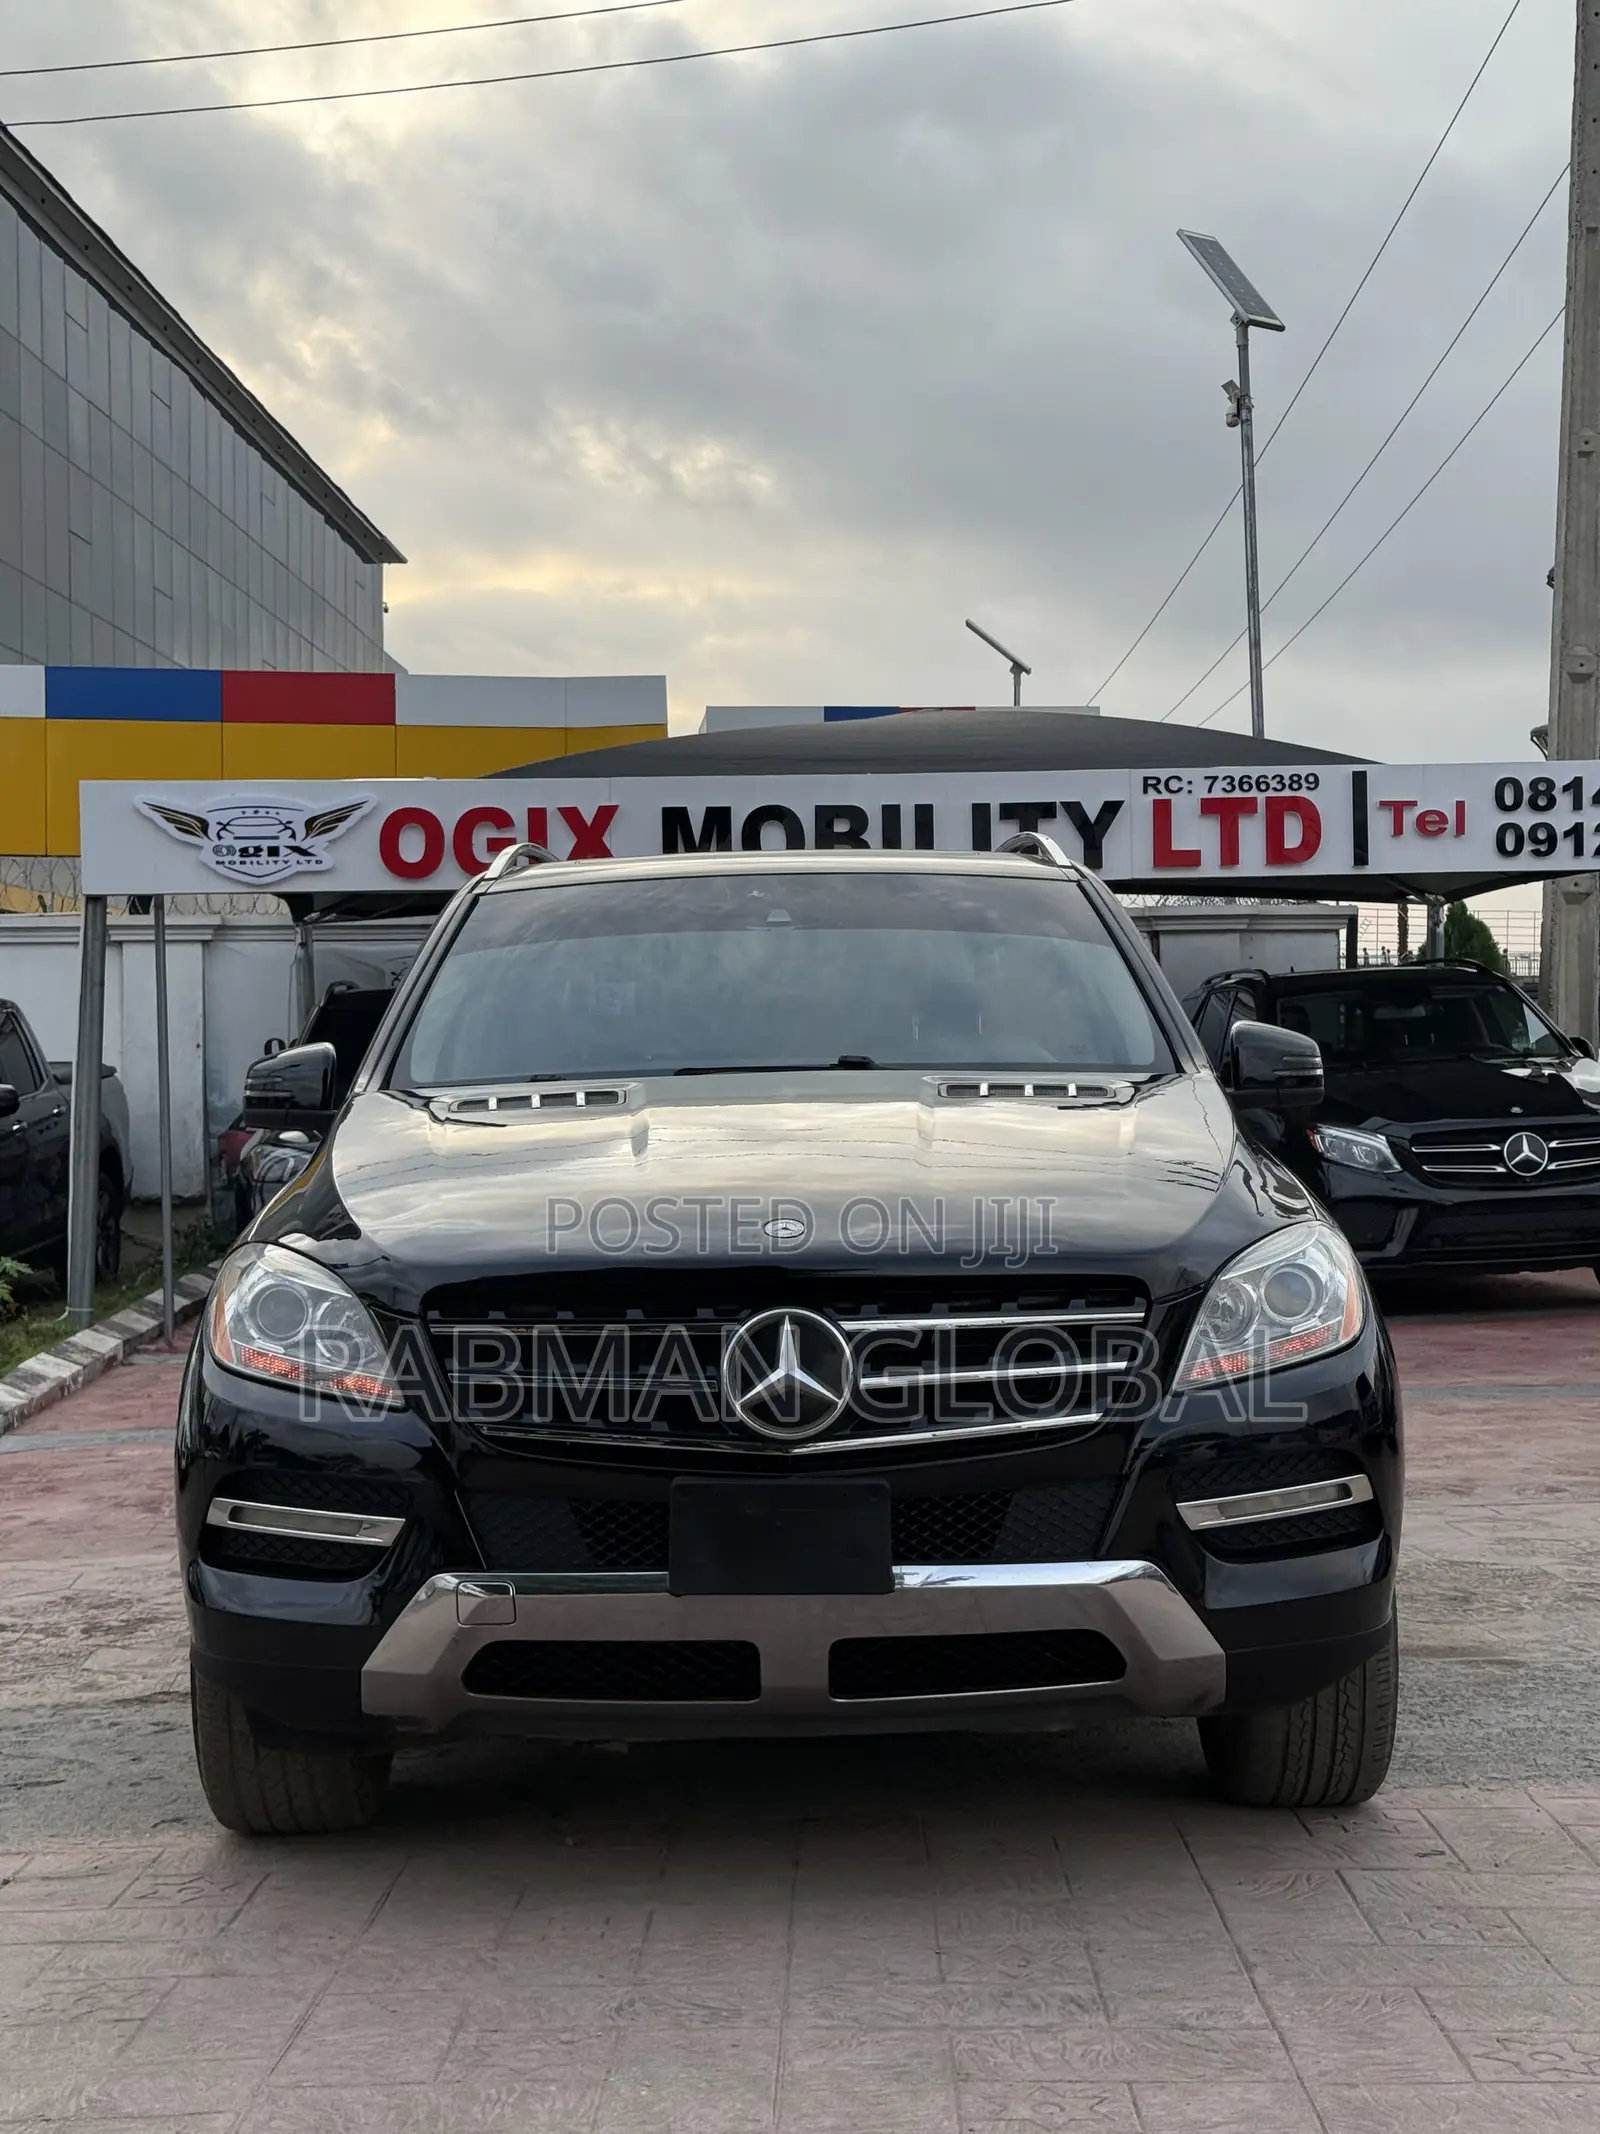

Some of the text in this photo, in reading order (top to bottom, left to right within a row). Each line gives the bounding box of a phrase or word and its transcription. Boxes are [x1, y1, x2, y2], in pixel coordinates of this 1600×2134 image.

[1142, 772, 1320, 794] RC: 7366389
[379, 795, 1322, 879] OGIX MOBILITY LTD
[1379, 800, 1466, 837] Tel
